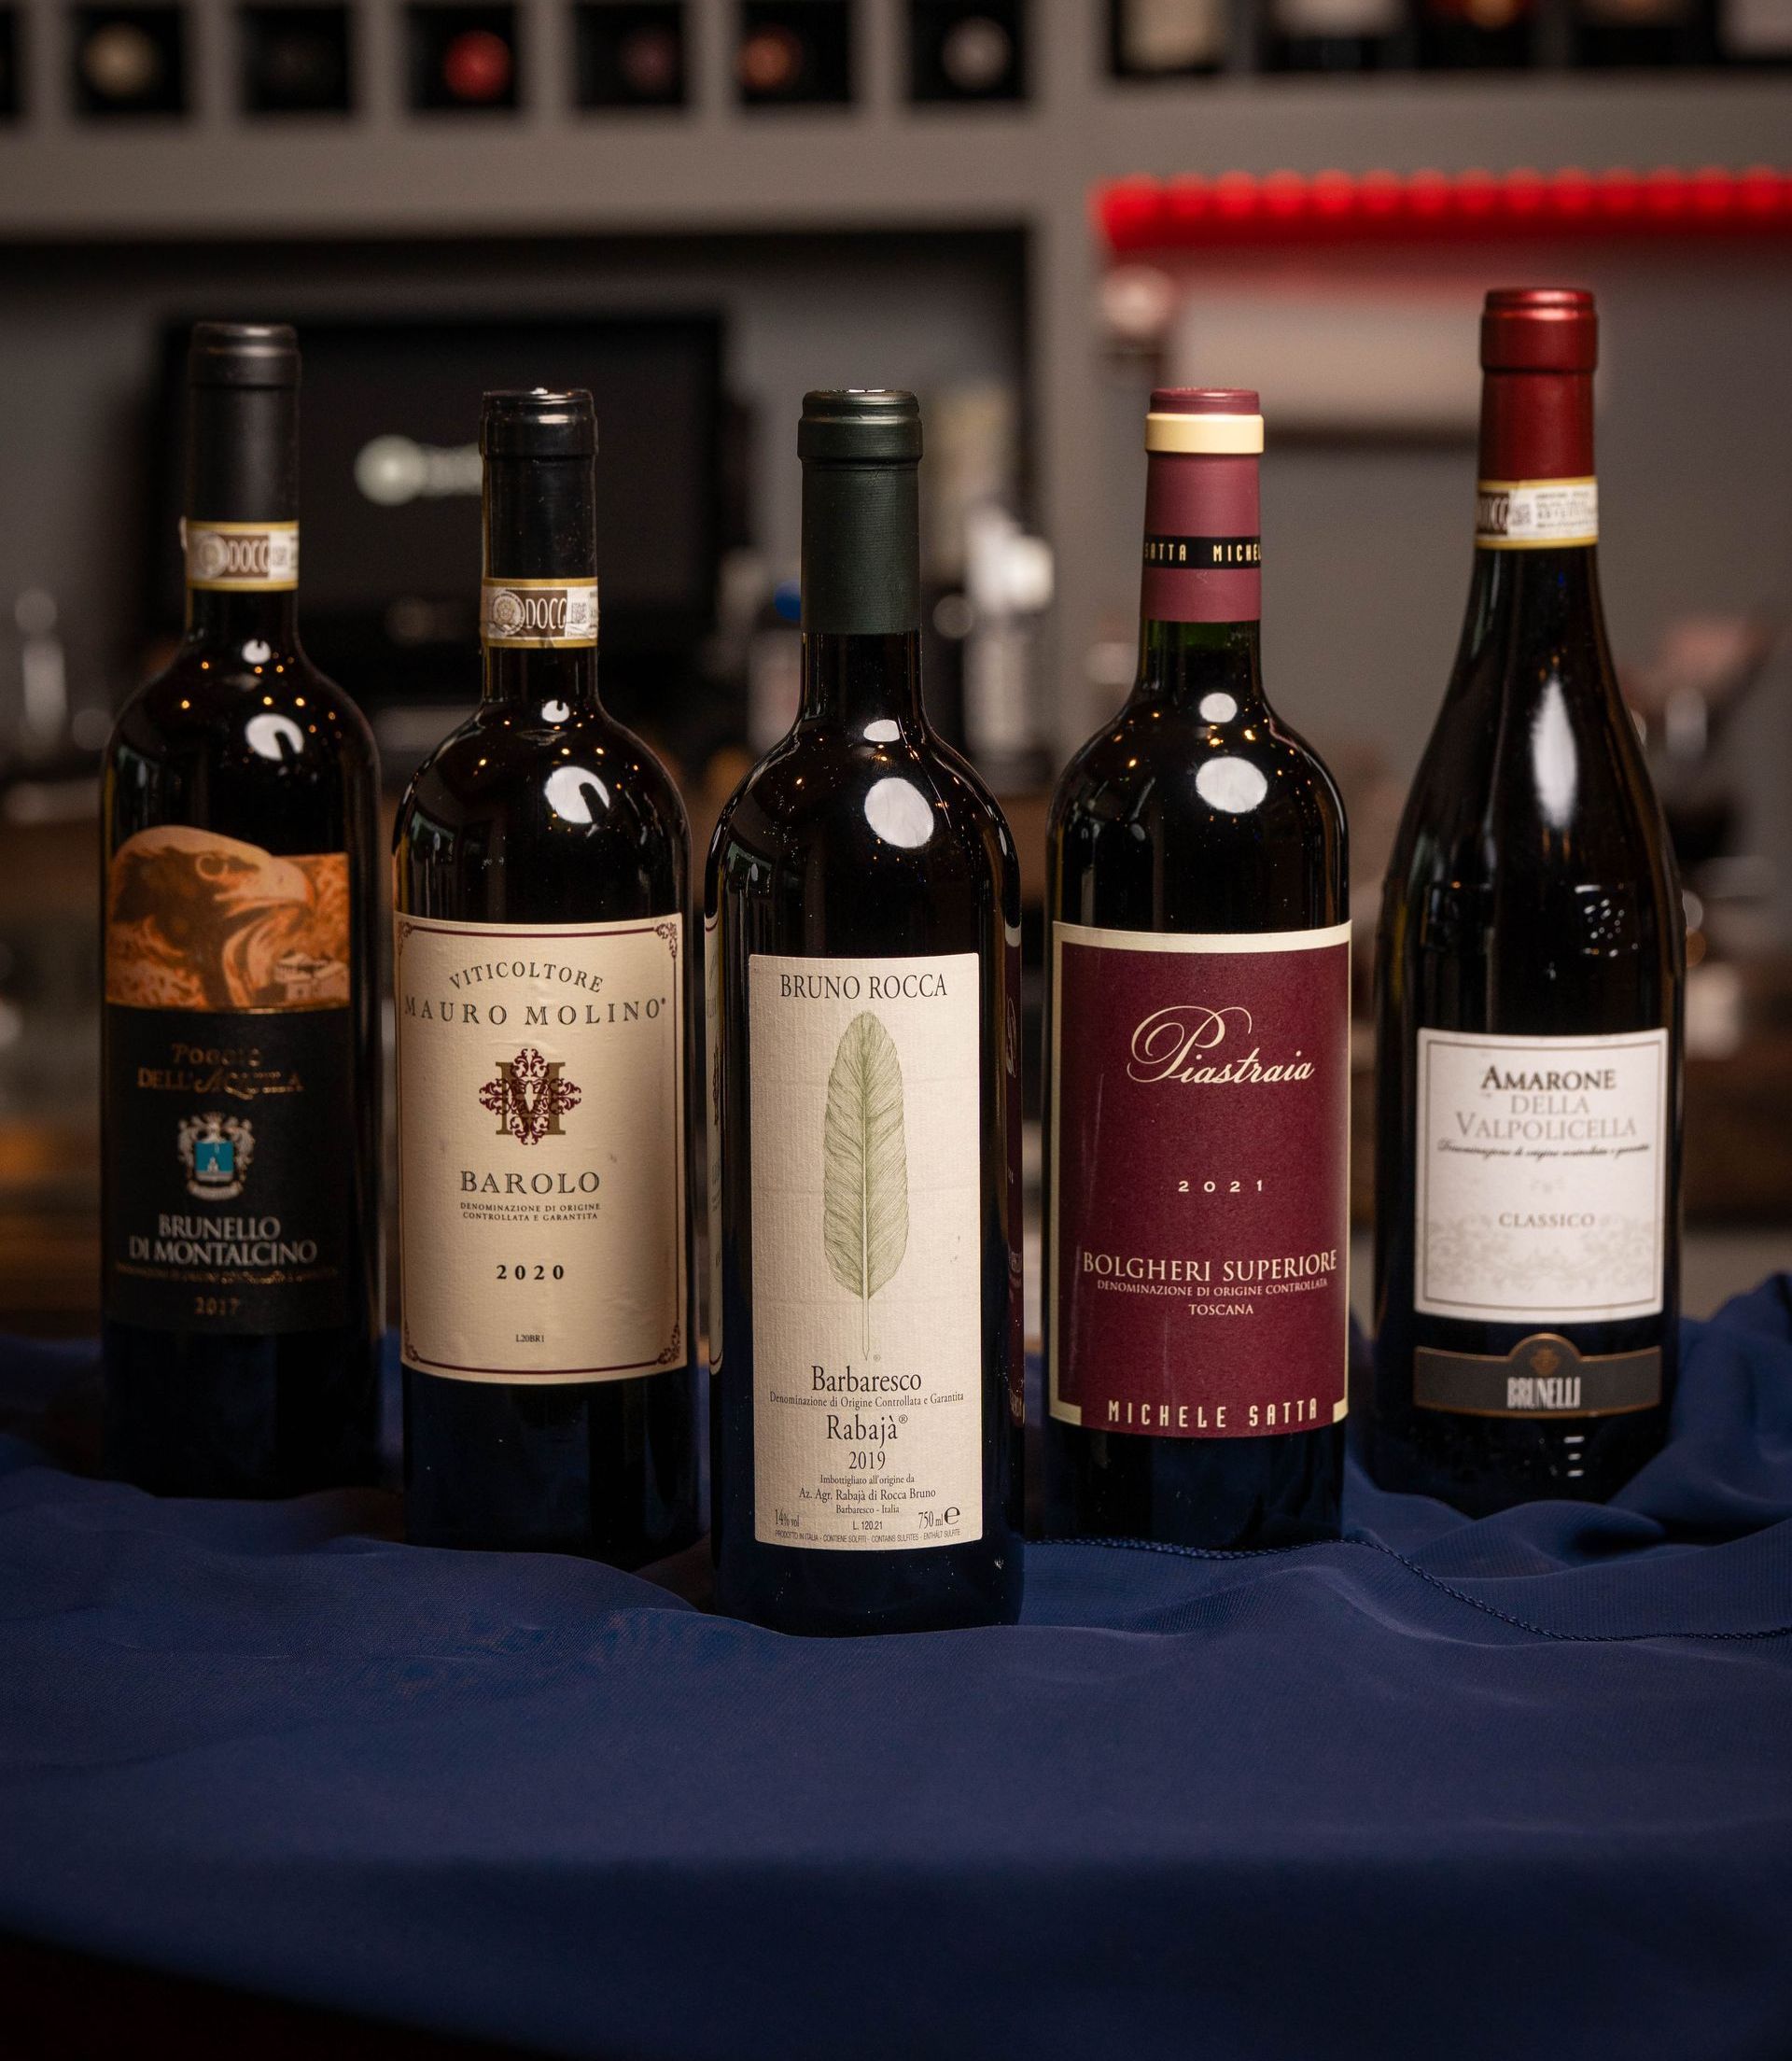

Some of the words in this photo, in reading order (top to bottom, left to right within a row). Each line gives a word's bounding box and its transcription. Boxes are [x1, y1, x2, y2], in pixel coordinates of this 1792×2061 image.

[1144, 541, 1187, 562] SATTA
[525, 597, 567, 629] DOCG
[449, 960, 604, 993] VITICOLTORE
[780, 974, 861, 1000] BRUNO
[869, 974, 948, 999] ROCCA
[404, 995, 508, 1026] MAURO
[1127, 1005, 1315, 1084] Piastraia
[1480, 1065, 1617, 1092] AMARONE
[1510, 1095, 1590, 1116] DELLA
[1456, 1111, 1637, 1142] VALPOLICELLA
[460, 1171, 600, 1195] BAROLO
[1178, 1179, 1263, 1193] 2021
[460, 1201, 540, 1213] DENOMINAZIONE
[559, 1203, 600, 1213] ORIGINE
[462, 1212, 530, 1222] CONTROLLATA
[534, 1213, 539, 1222] E
[542, 1213, 597, 1222] GARANTITA
[159, 1213, 281, 1241] BRUNELLO
[1498, 1212, 1596, 1228] CLASSICO
[129, 1235, 150, 1261] DI
[153, 1240, 318, 1267] MONTALCINO
[497, 1265, 564, 1280] 2020
[1083, 1252, 1211, 1283] BOLGHERI
[1223, 1249, 1337, 1283] SUPERIORE
[1097, 1280, 1194, 1297] DENOMINAZIONE
[1197, 1285, 1211, 1297] DI
[1213, 1285, 1263, 1297] ORIGINE
[1265, 1278, 1328, 1295] CONTROLLATA
[194, 1296, 241, 1316] 2017
[1188, 1303, 1254, 1316] TOSCANA
[811, 1366, 922, 1392] Barbaresco
[769, 1391, 827, 1407] Denominazione
[831, 1395, 838, 1407] di
[841, 1395, 873, 1410] Origine
[875, 1392, 922, 1407] Controllata
[924, 1396, 929, 1405] e
[931, 1392, 964, 1404] Garantita
[1505, 1377, 1581, 1409] BRUNELLI
[1109, 1400, 1226, 1428] MICHELE
[1249, 1398, 1317, 1426] SATTA
[848, 1451, 886, 1470] 2019
[819, 1474, 867, 1487] Imbottigliato
[906, 1473, 915, 1483] da
[799, 1487, 813, 1499] Az.
[816, 1488, 833, 1503] Agr.
[836, 1488, 866, 1504] Rabajà
[868, 1489, 877, 1500] di
[880, 1489, 907, 1500] Rocca
[909, 1487, 936, 1499] Bruno
[836, 1504, 875, 1514] Barbaresco
[882, 1504, 900, 1514] Italia
[853, 1521, 860, 1531] L.
[861, 1521, 883, 1531] 120.21
[918, 1510, 933, 1529] 750
[935, 1514, 944, 1526] ml
[800, 1532, 805, 1540] IN
[805, 1532, 819, 1541] ITALIA
[823, 1534, 847, 1543] CONTIENE
[871, 1534, 896, 1543] CONTAINS
[897, 1533, 919, 1542] SULFITES
